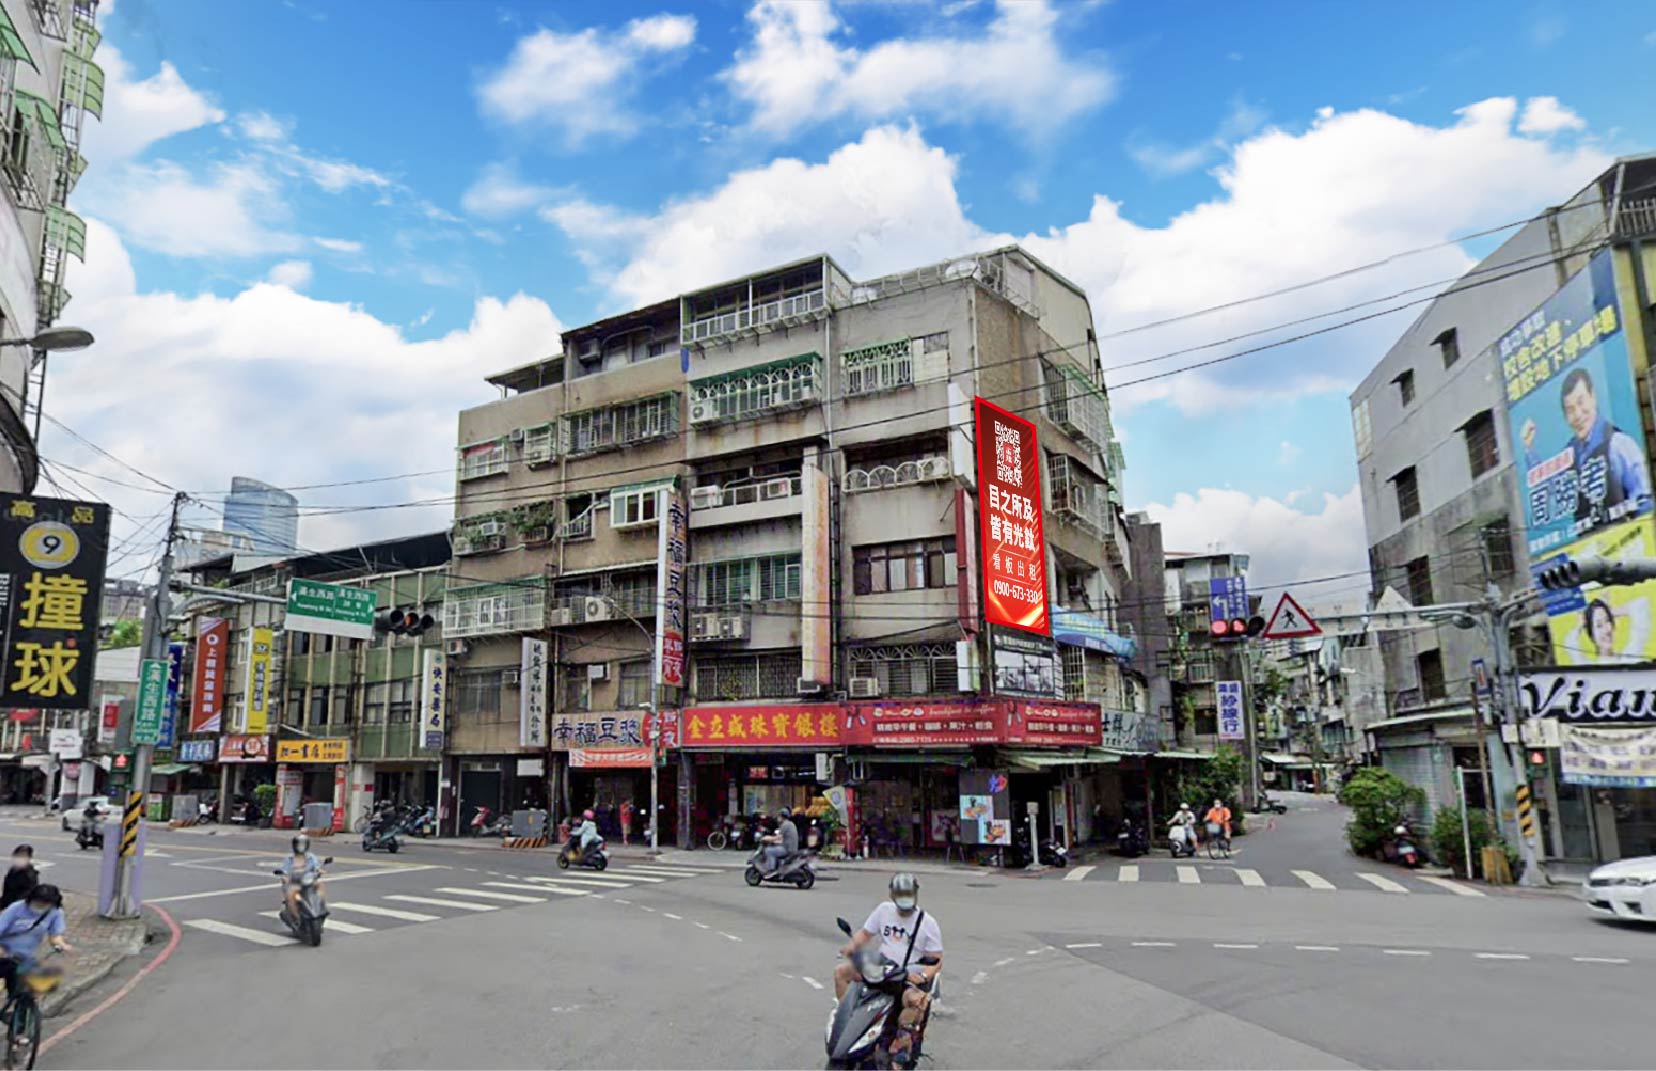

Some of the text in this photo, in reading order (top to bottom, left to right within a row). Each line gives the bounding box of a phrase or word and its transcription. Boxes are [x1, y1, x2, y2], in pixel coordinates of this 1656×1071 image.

[988, 484, 1035, 523] 目之所及
[43, 535, 61, 555] 9
[992, 552, 1037, 582] 看板出租
[993, 578, 1039, 605] 0900-673-330
[10, 571, 88, 697] 撞球
[554, 716, 641, 746] 幸福豆漿
